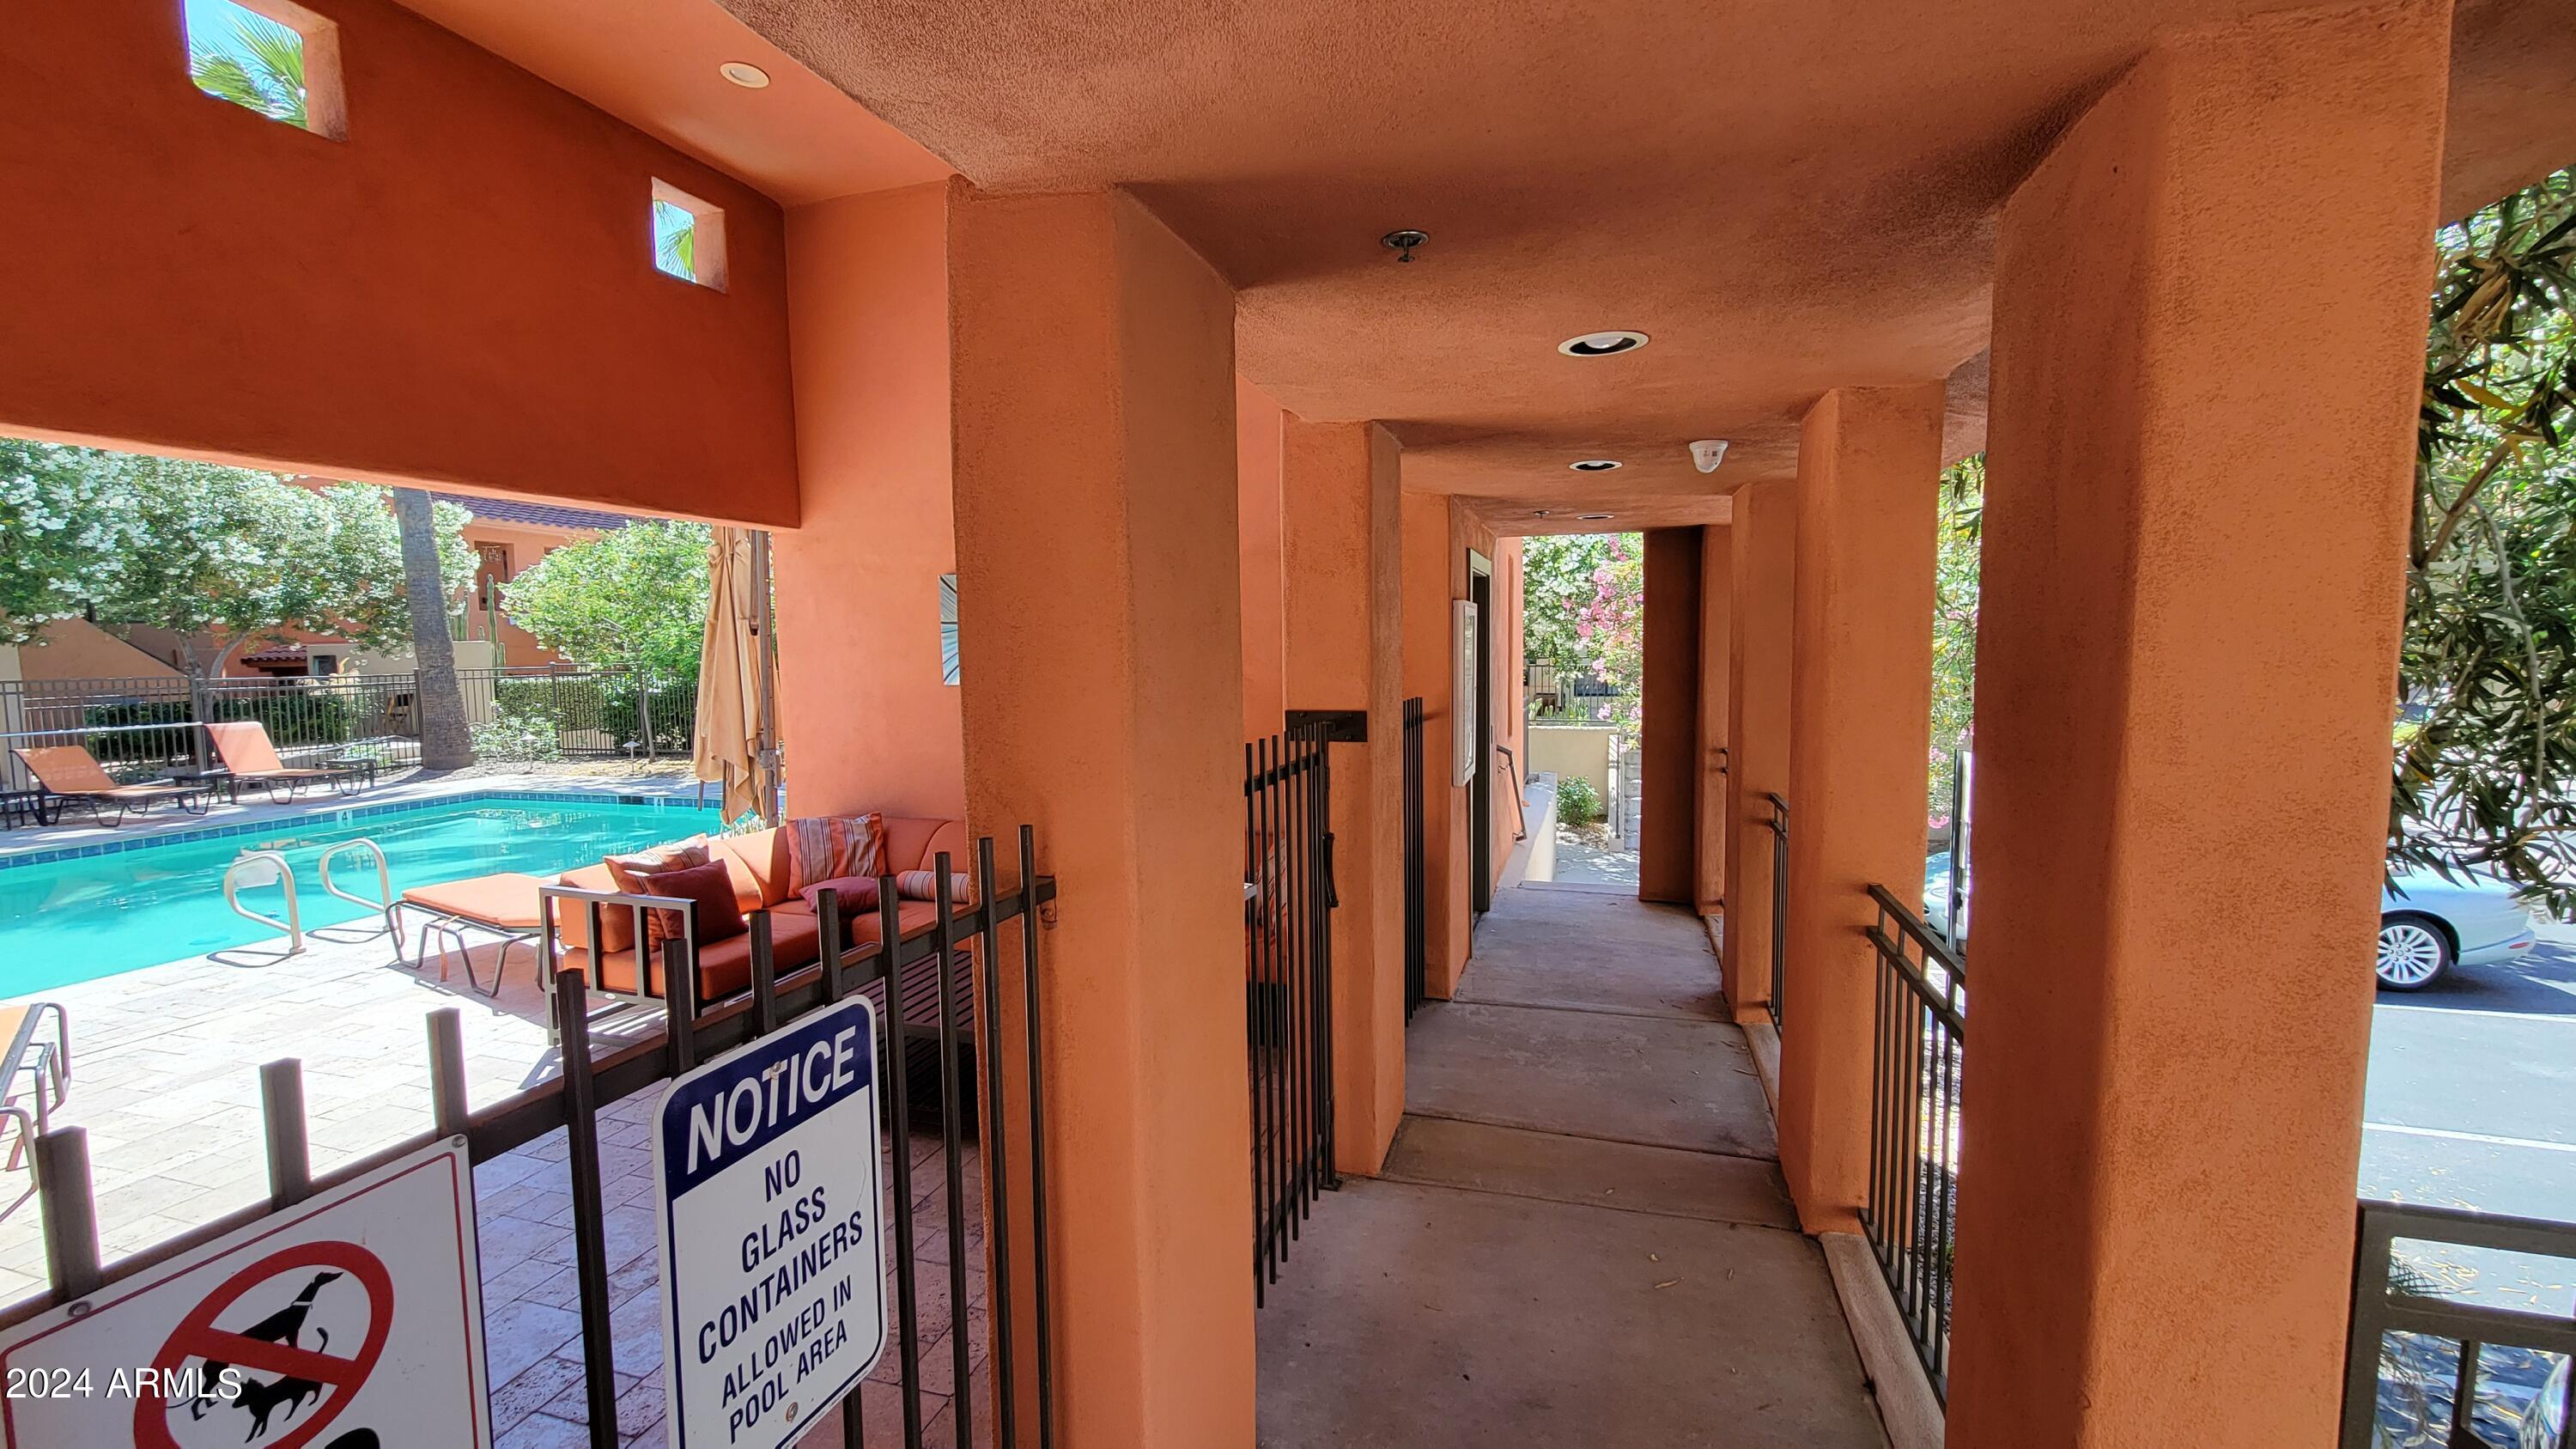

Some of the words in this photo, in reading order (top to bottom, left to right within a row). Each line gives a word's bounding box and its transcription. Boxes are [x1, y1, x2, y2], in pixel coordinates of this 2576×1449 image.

[687, 1026, 856, 1175] NOTICE
[741, 1185, 826, 1274] GLASS
[765, 1149, 800, 1202] NO
[698, 1210, 863, 1364] CONTAINERS
[721, 1297, 825, 1409] ALLOWED
[834, 1275, 853, 1312] IN
[730, 1372, 789, 1445] POOL
[796, 1318, 848, 1385] AREA
